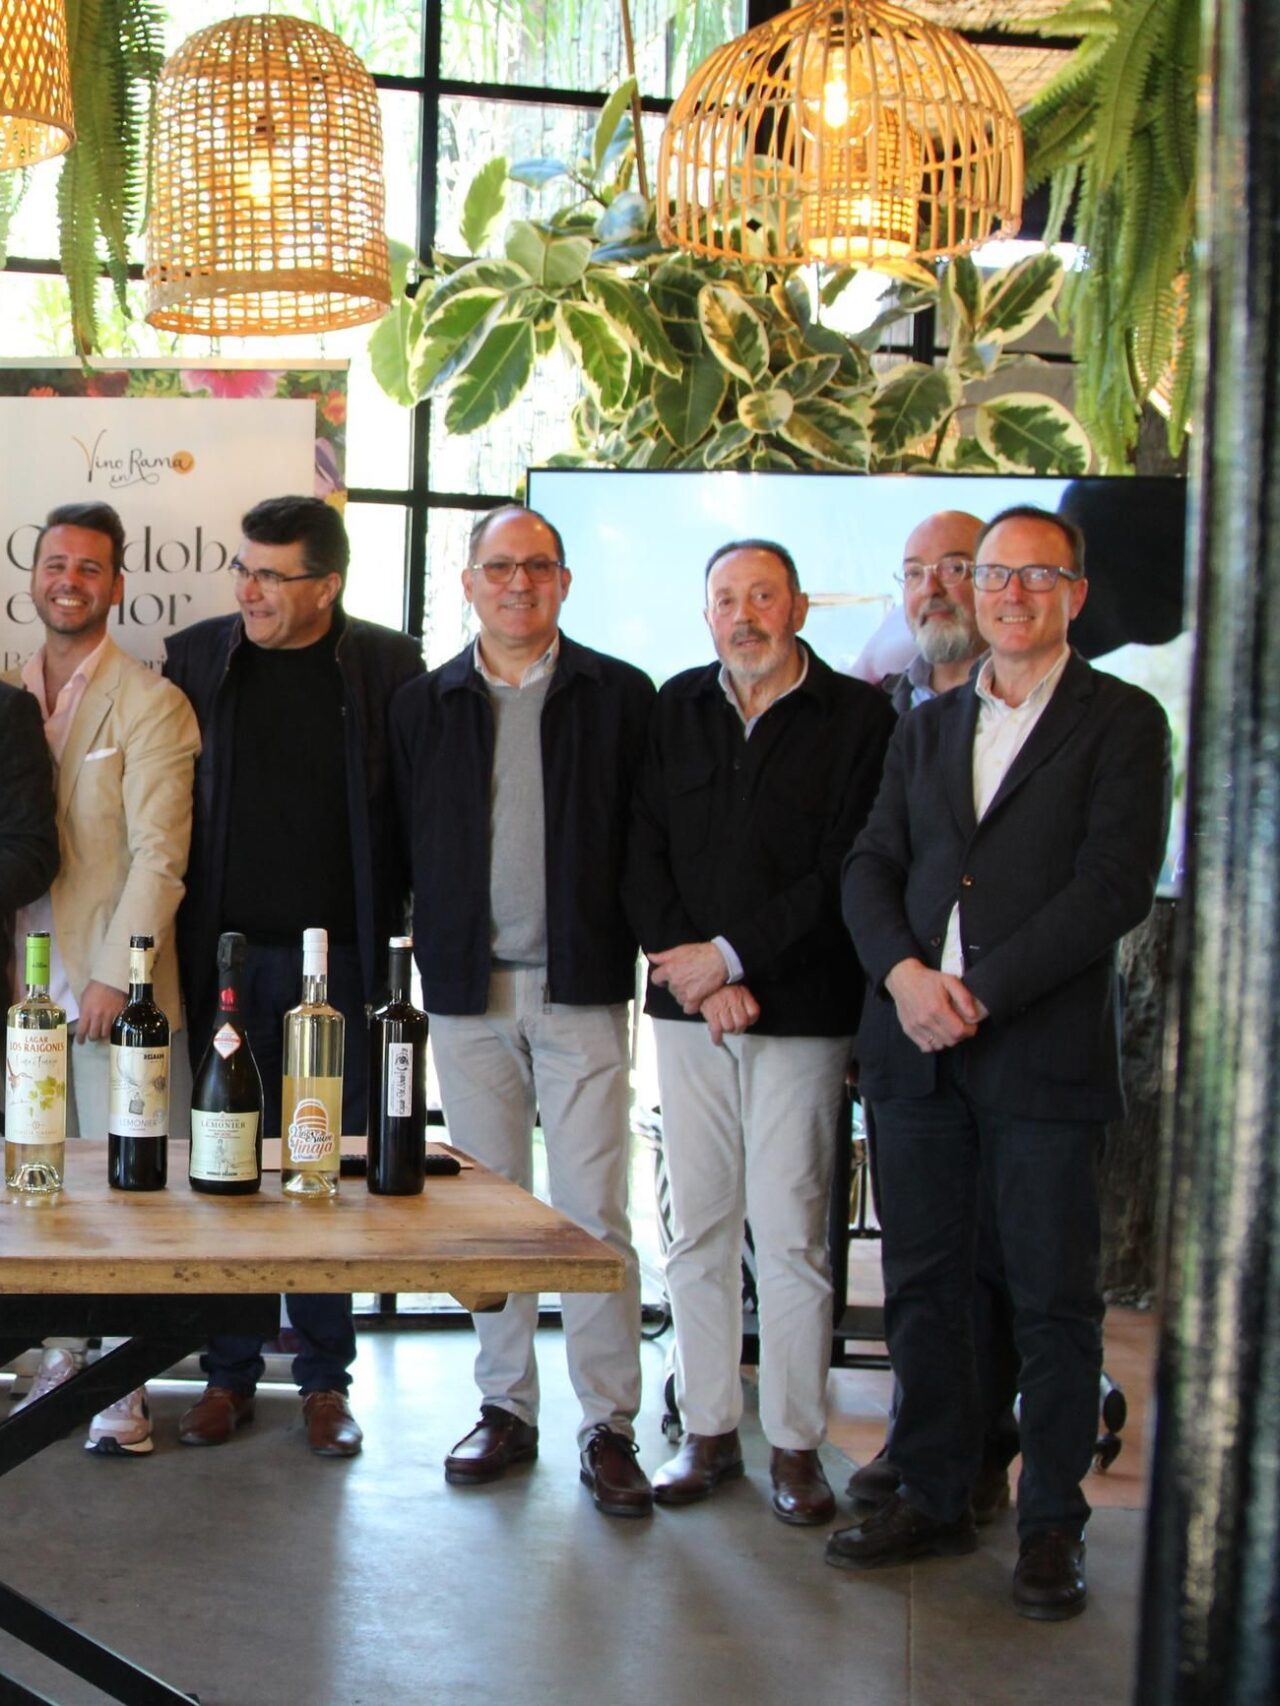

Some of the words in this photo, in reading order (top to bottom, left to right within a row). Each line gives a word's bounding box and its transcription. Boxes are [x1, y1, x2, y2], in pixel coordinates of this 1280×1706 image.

[72, 428, 123, 483] Vino
[129, 448, 194, 481] Rama
[25, 1035, 49, 1043] LAGAR
[10, 1043, 22, 1051] LOS
[24, 1043, 64, 1052] RAIGONES
[201, 1121, 246, 1129] LEMONIER
